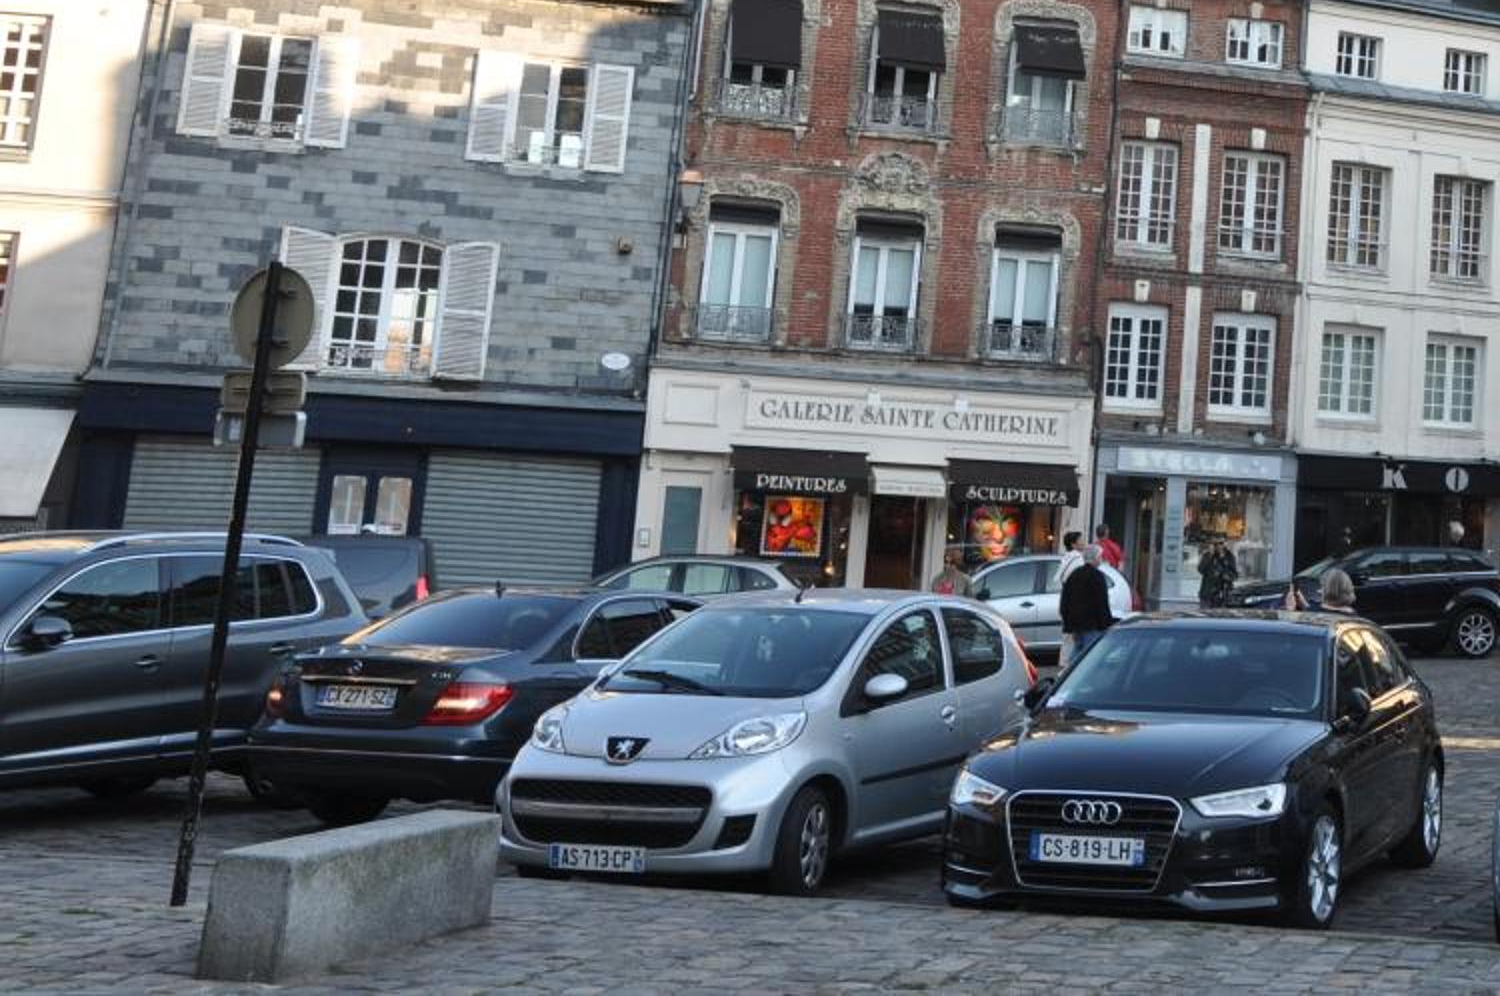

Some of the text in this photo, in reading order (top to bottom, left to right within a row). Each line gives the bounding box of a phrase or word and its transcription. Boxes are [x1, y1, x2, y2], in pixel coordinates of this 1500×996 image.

[760, 399, 1058, 436] GALERIE SAINTE CATHERINE
[756, 473, 847, 493] PEINTURES
[965, 485, 1068, 505] SCULPTURES
